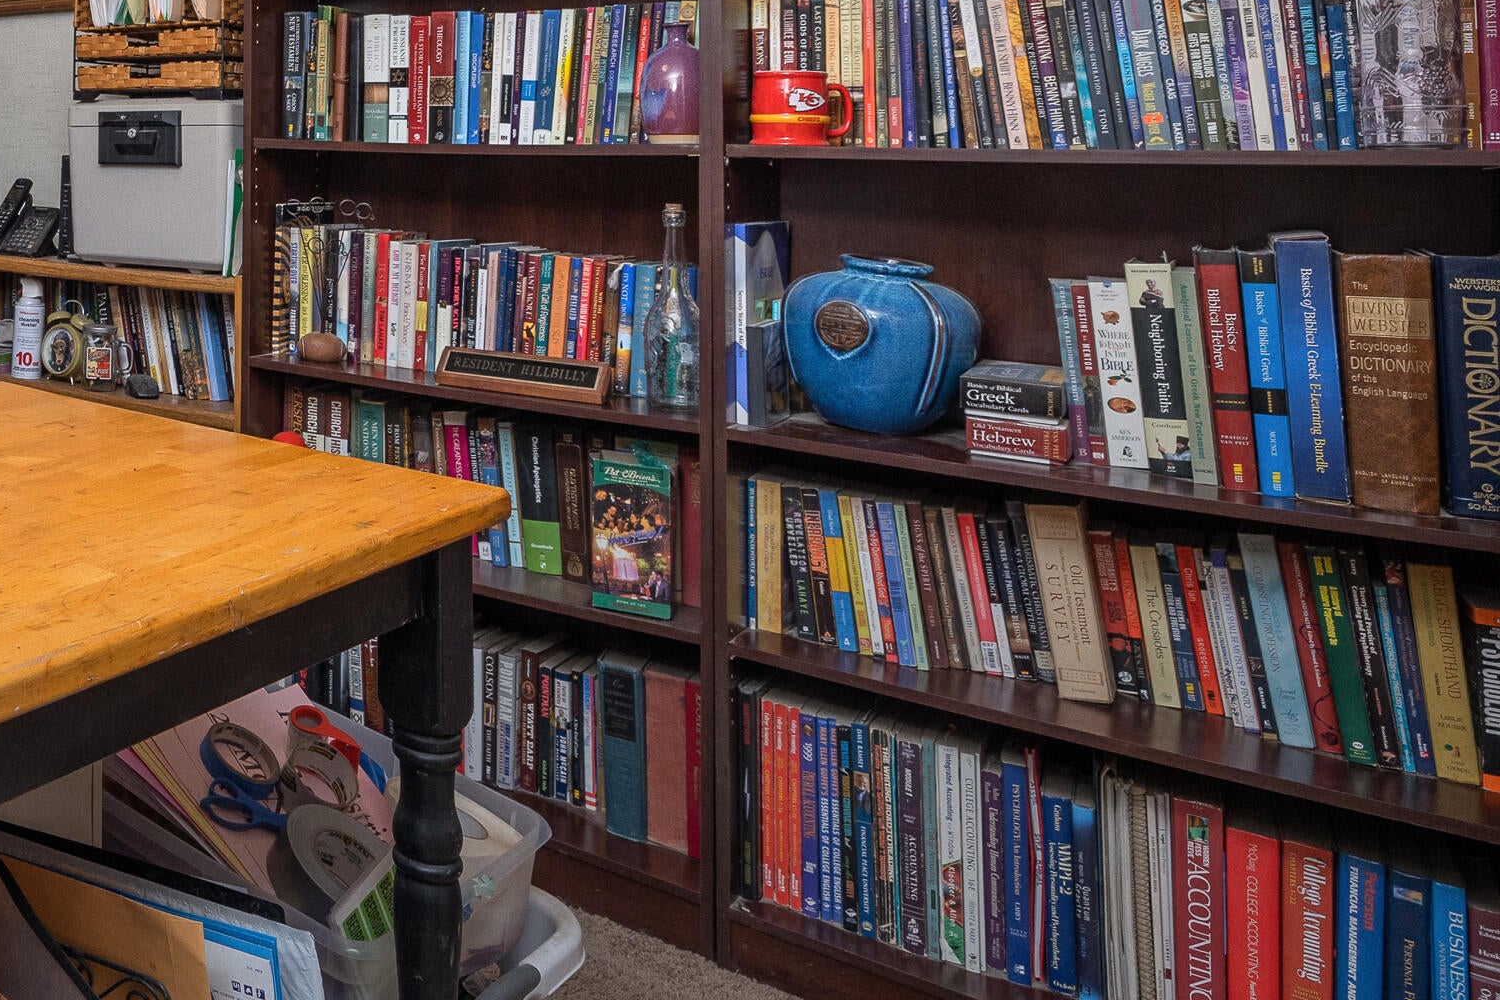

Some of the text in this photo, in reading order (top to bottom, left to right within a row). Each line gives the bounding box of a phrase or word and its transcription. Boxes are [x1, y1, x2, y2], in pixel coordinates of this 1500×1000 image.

[435, 25, 443, 64] THEOLOGY
[610, 29, 619, 68] RESEARCH
[1486, 22, 1497, 39] LIFE
[1290, 36, 1302, 69] Assignment
[1033, 20, 1065, 131] ANOINTING BENNY HINN
[1221, 84, 1230, 100] GOD
[1003, 82, 1019, 131] BENNY HINN
[1165, 78, 1184, 145] CRAIG BAKER
[1489, 89, 1499, 107] COLE
[1098, 109, 1108, 134] STONE
[1184, 106, 1196, 134] HAGEE
[1351, 281, 1368, 290] The
[1225, 312, 1237, 343] Basics
[1351, 303, 1406, 316] LIVING
[1353, 317, 1428, 334] WEBSTER
[1076, 295, 1093, 371] AUGUSTINE MENTOR
[1097, 330, 1130, 340] WHERE
[1206, 288, 1224, 371] Biblical Hebrew
[1255, 291, 1270, 383] Basics Biblical Greek
[1349, 339, 1419, 353] Encyclopedic
[16, 352, 33, 367] 10
[453, 357, 589, 383] RESIDENT HILLBILLY
[1100, 358, 1134, 372] BIBLE
[1147, 314, 1170, 414] Neighboring Faiths
[1300, 268, 1329, 474] Basics Biblical Greek E-Learning Bundle
[1350, 356, 1433, 374] DICTIONARY
[966, 389, 1015, 405] Greek
[967, 381, 1022, 393] Basics Biblical
[1352, 386, 1428, 401] English Language
[1462, 296, 1500, 476] DICTIONARY
[308, 397, 318, 433] CHURCH
[331, 401, 341, 438] CHURCH
[966, 401, 1029, 414] Vocabulary Cards
[972, 422, 1022, 434] Old Testament
[972, 429, 1037, 448] Hebrew
[1110, 434, 1141, 442] ANDERSON
[971, 441, 1035, 455] Vocabulary Cards
[531, 436, 542, 504] Christian Apologetics
[785, 518, 797, 566] UNVEILED
[794, 512, 808, 573] REVELATION
[804, 510, 828, 574] INERRANCY
[796, 580, 808, 615] LAHAYE
[1045, 563, 1071, 645] SURVEY
[1070, 565, 1092, 645] Old Testament
[1145, 587, 1168, 660] The Crusades
[1197, 638, 1210, 677] GROESCHEL
[1438, 616, 1462, 699] SHORTHAND
[484, 655, 495, 700] COLSON
[526, 703, 534, 733] WYATT
[559, 754, 567, 784] MCCAIN
[804, 742, 813, 761] 1999
[967, 810, 976, 872] ACCOUNTING
[1058, 842, 1072, 895] MMPI-2
[1364, 871, 1378, 931] Peterson
[1247, 876, 1259, 982] COLLEGE ACCOUNTING
[1297, 857, 1327, 984] College Accounting
[1348, 866, 1359, 980] FINANCIAL MANAGEMENT
[1404, 938, 1415, 986] PERSONAL
